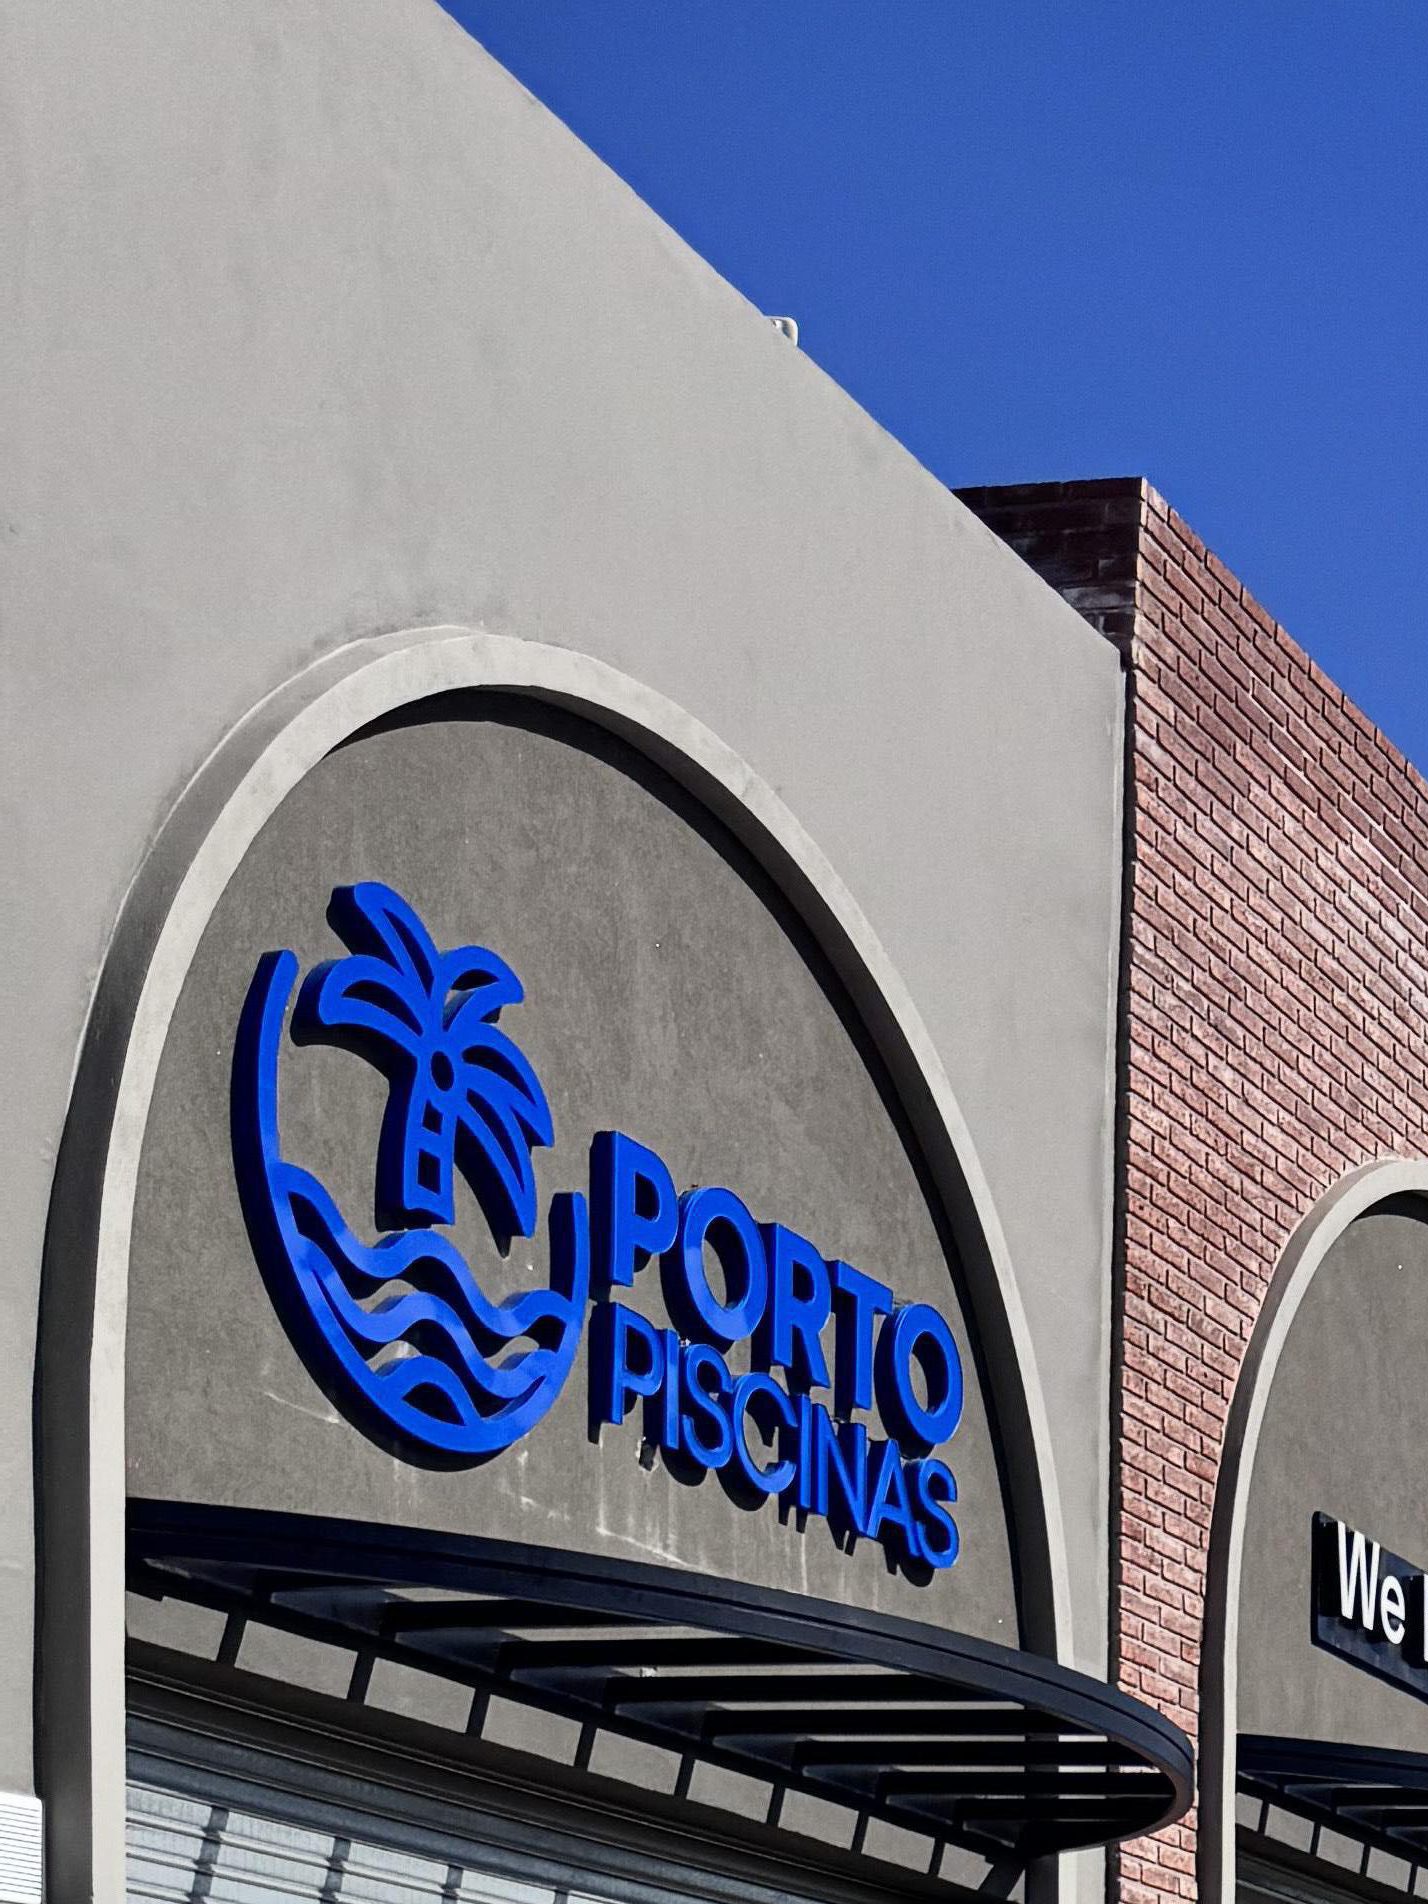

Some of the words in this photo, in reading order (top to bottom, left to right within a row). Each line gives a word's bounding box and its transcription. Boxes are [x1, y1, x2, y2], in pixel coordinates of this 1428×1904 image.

[598, 1130, 964, 1446] PORTO
[603, 1301, 961, 1569] PISCINAS
[1337, 1520, 1406, 1644] We
